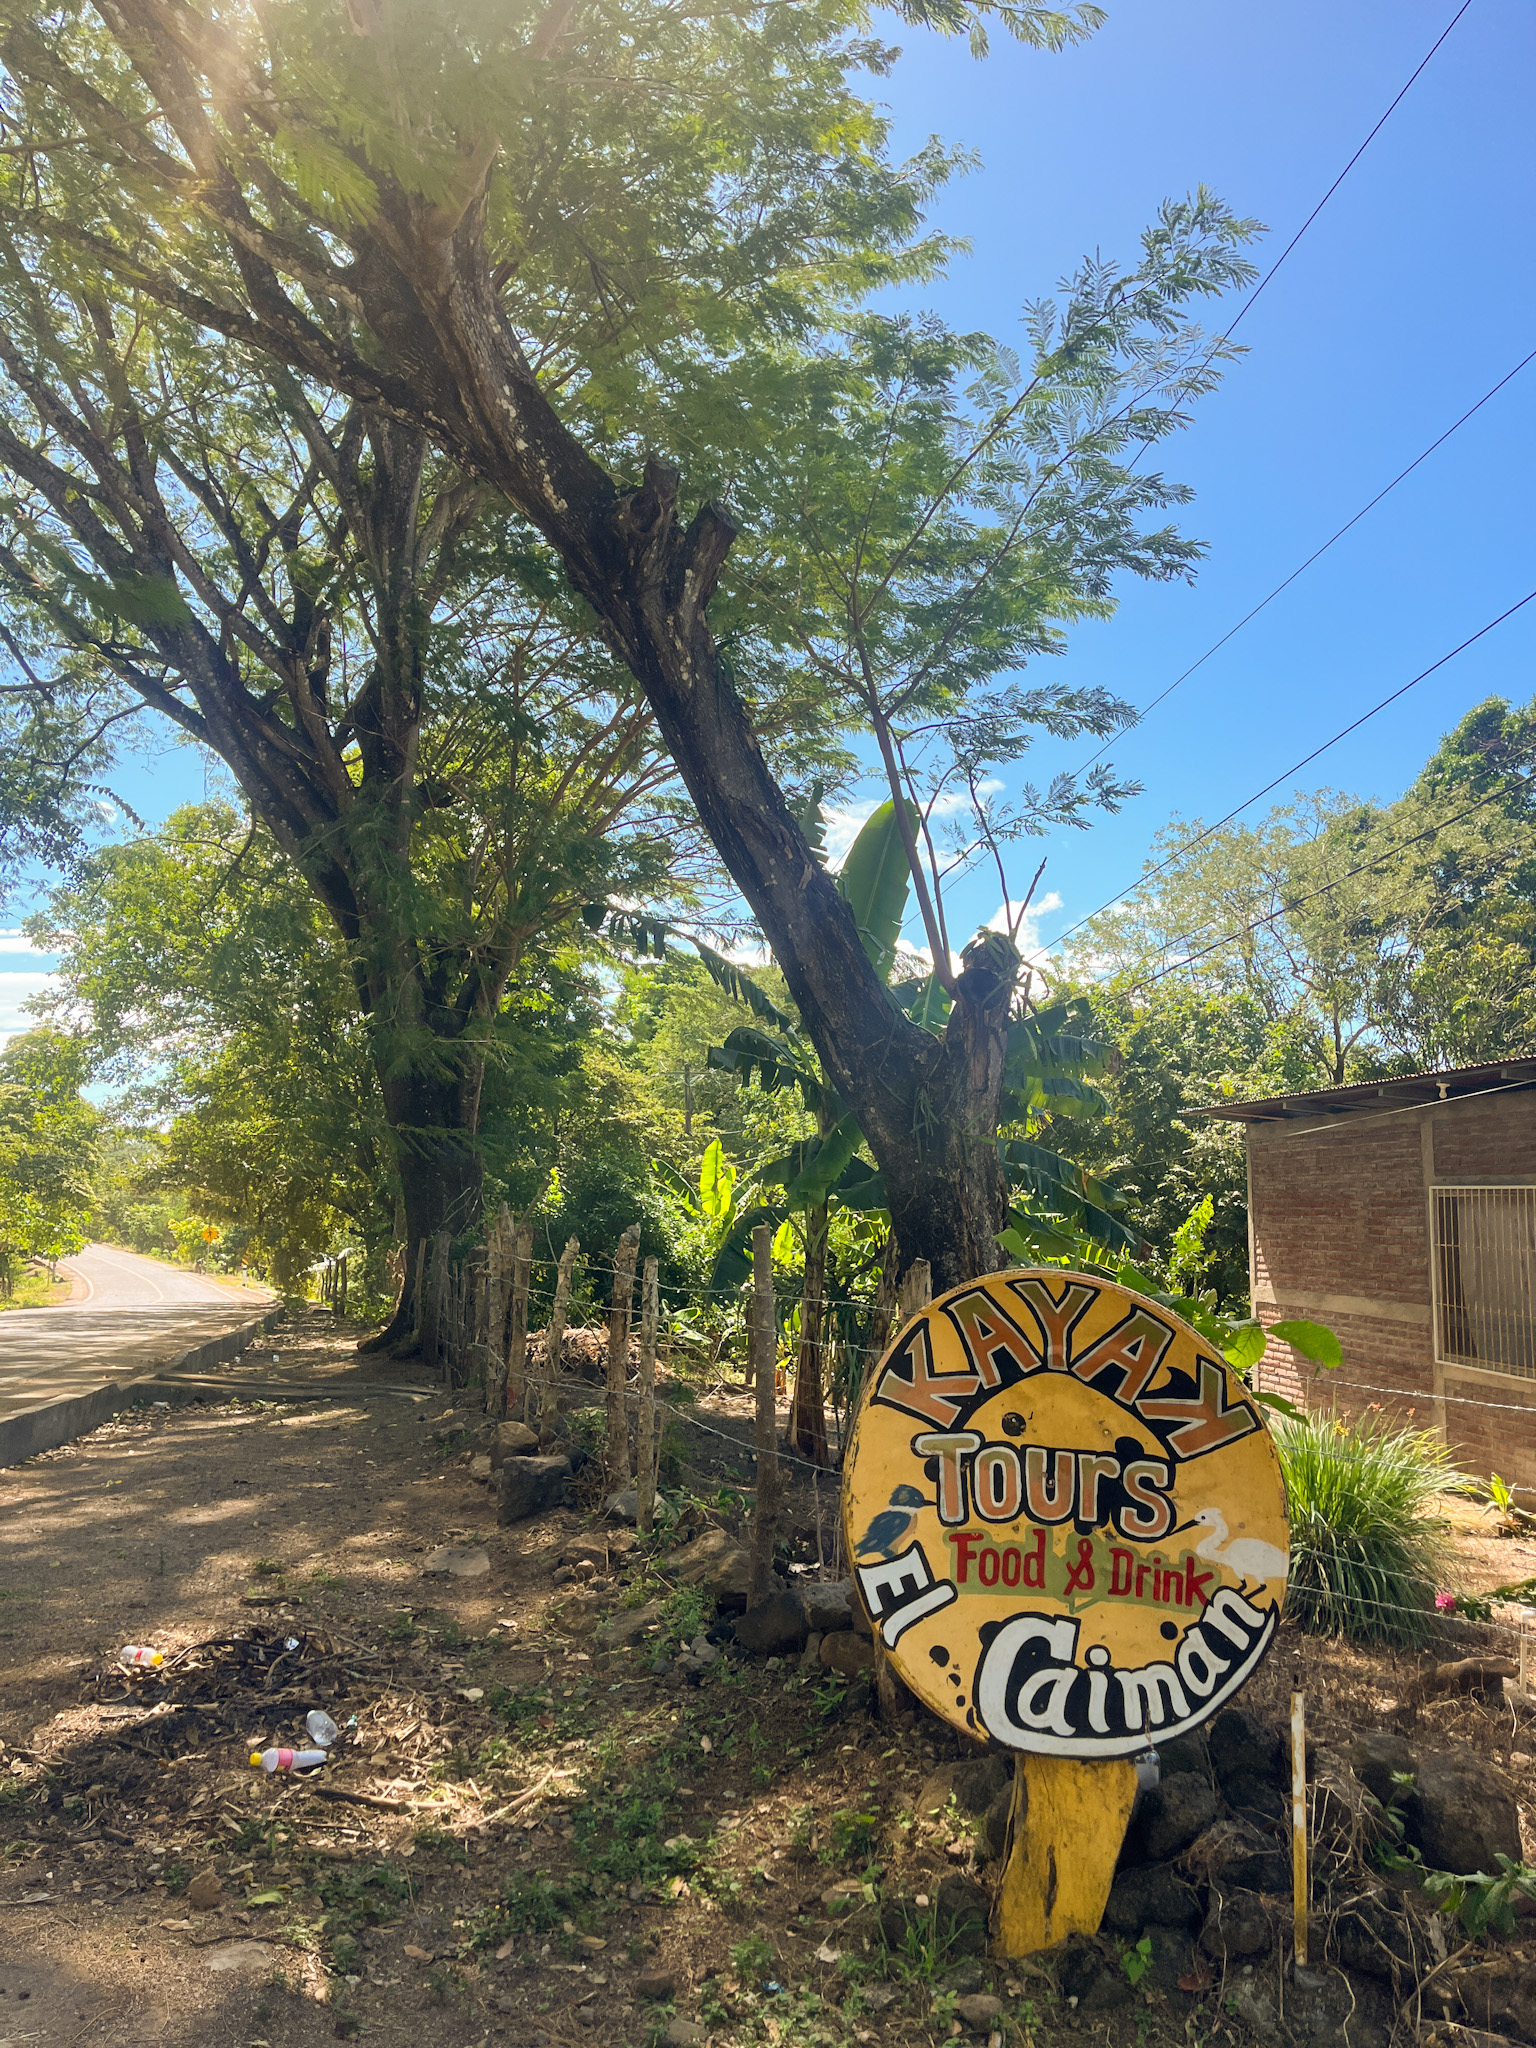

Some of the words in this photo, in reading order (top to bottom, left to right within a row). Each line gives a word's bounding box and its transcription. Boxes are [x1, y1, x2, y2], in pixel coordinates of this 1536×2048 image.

[873, 1279, 1260, 1459] KAYAK
[914, 1432, 1176, 1541] Tours
[948, 1529, 1046, 1588] Food
[1107, 1547, 1217, 1607] Drink
[978, 1589, 1276, 1756] Caiman
